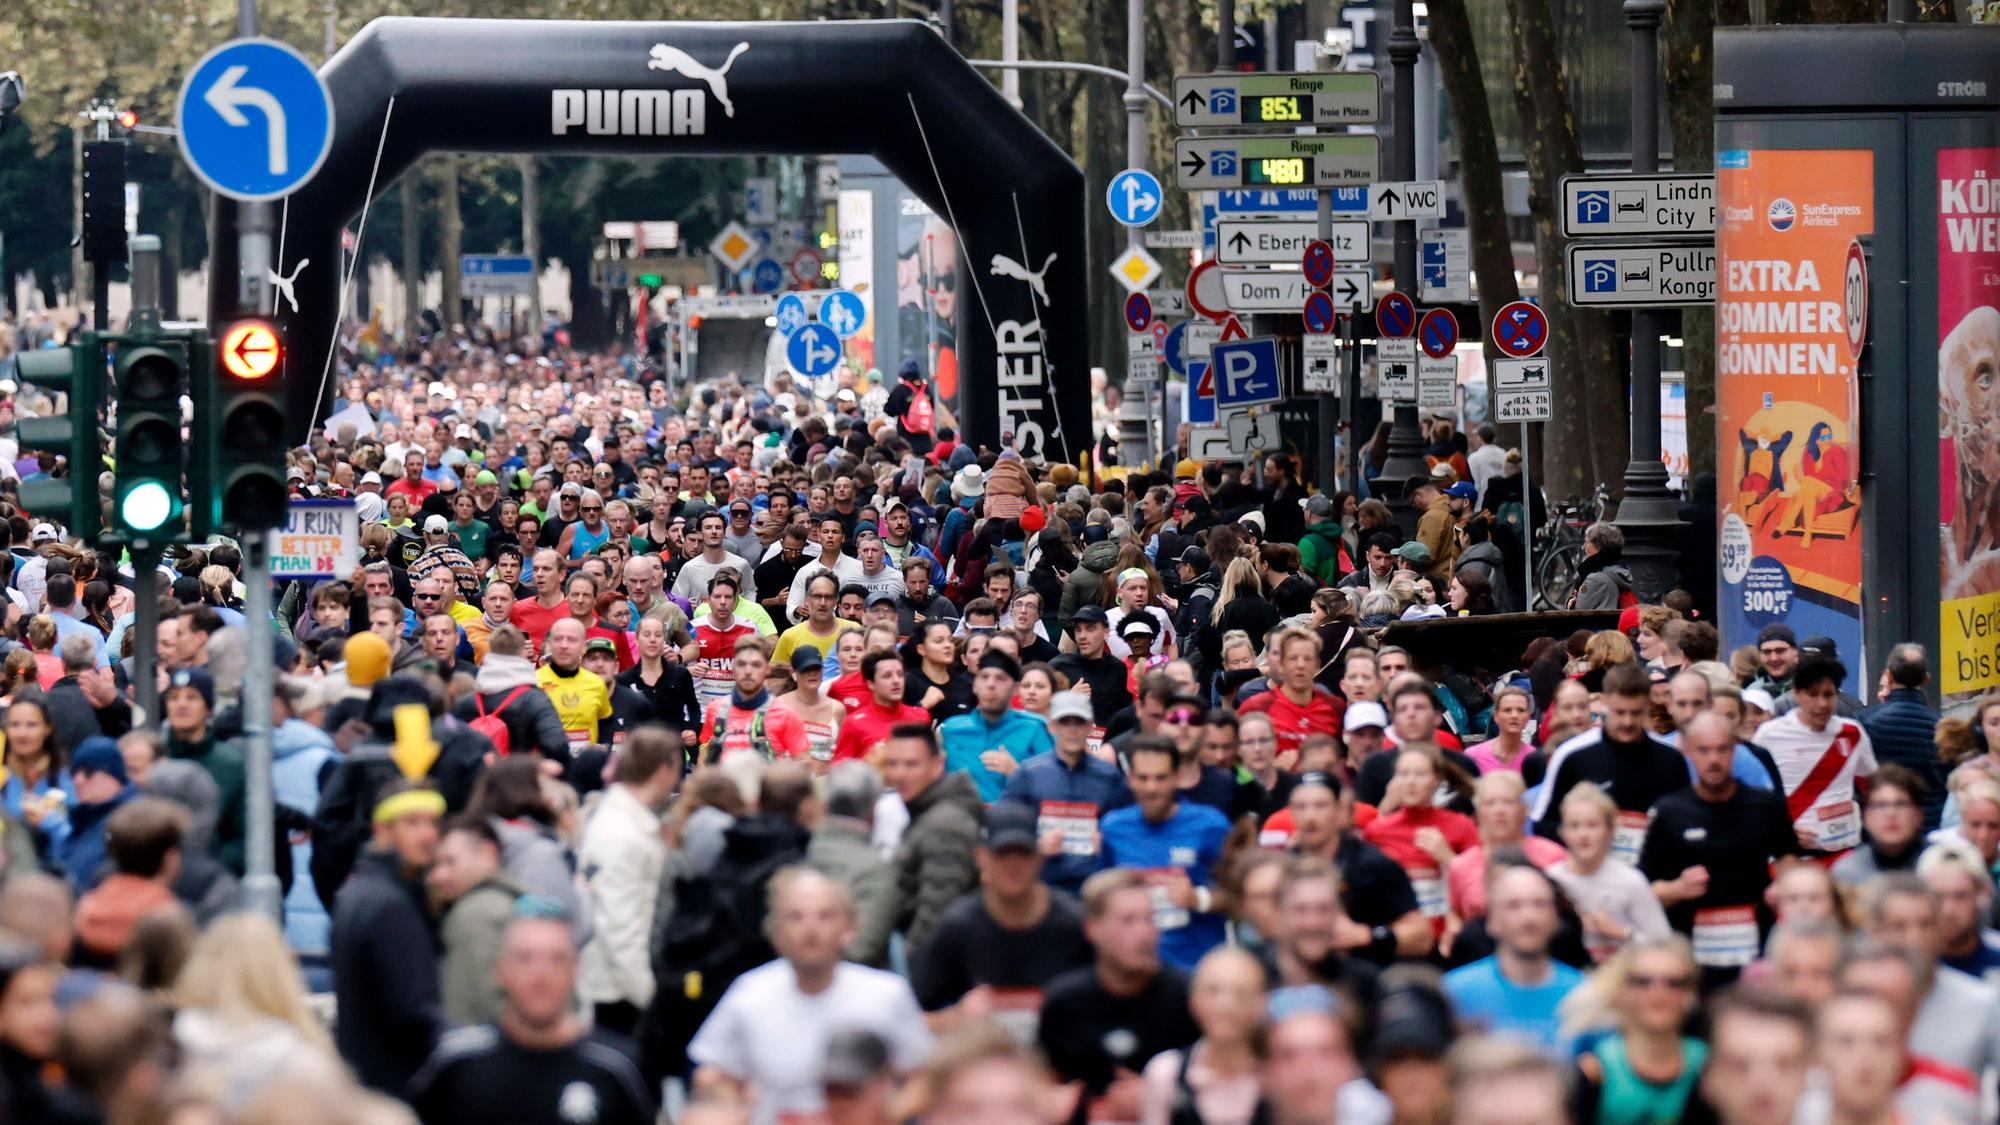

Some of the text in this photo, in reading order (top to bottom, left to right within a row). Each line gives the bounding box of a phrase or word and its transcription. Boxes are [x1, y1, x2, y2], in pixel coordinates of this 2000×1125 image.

[1290, 78, 1324, 92] Ringe
[1937, 80, 1987, 97] STRÖER
[552, 89, 706, 135] PUMA
[1260, 97, 1302, 121] 851
[1320, 106, 1370, 117] freie Plätze
[1291, 140, 1325, 155] Ringe
[1262, 159, 1304, 183] 480
[1321, 168, 1370, 179] freie Plätze
[1407, 191, 1436, 208] WC
[1802, 203, 1862, 216] SunExpress
[1656, 208, 1695, 229] City
[1802, 215, 1838, 226] Airlines
[1259, 232, 1352, 250] Eberttz
[1946, 217, 2000, 253] WE
[1728, 260, 1821, 292] EXTRA
[1241, 283, 1280, 299] Dom
[1848, 274, 1861, 327] 30
[1720, 301, 1845, 333] SOMMER
[1720, 335, 1849, 375] GÖNNEN.
[1223, 350, 1257, 396] P
[996, 319, 1046, 464] STER
[304, 511, 342, 535] RUN
[281, 536, 344, 556] BETTER
[271, 555, 311, 572] THAN
[700, 657, 735, 671] REW
[1957, 647, 1991, 682] bis
